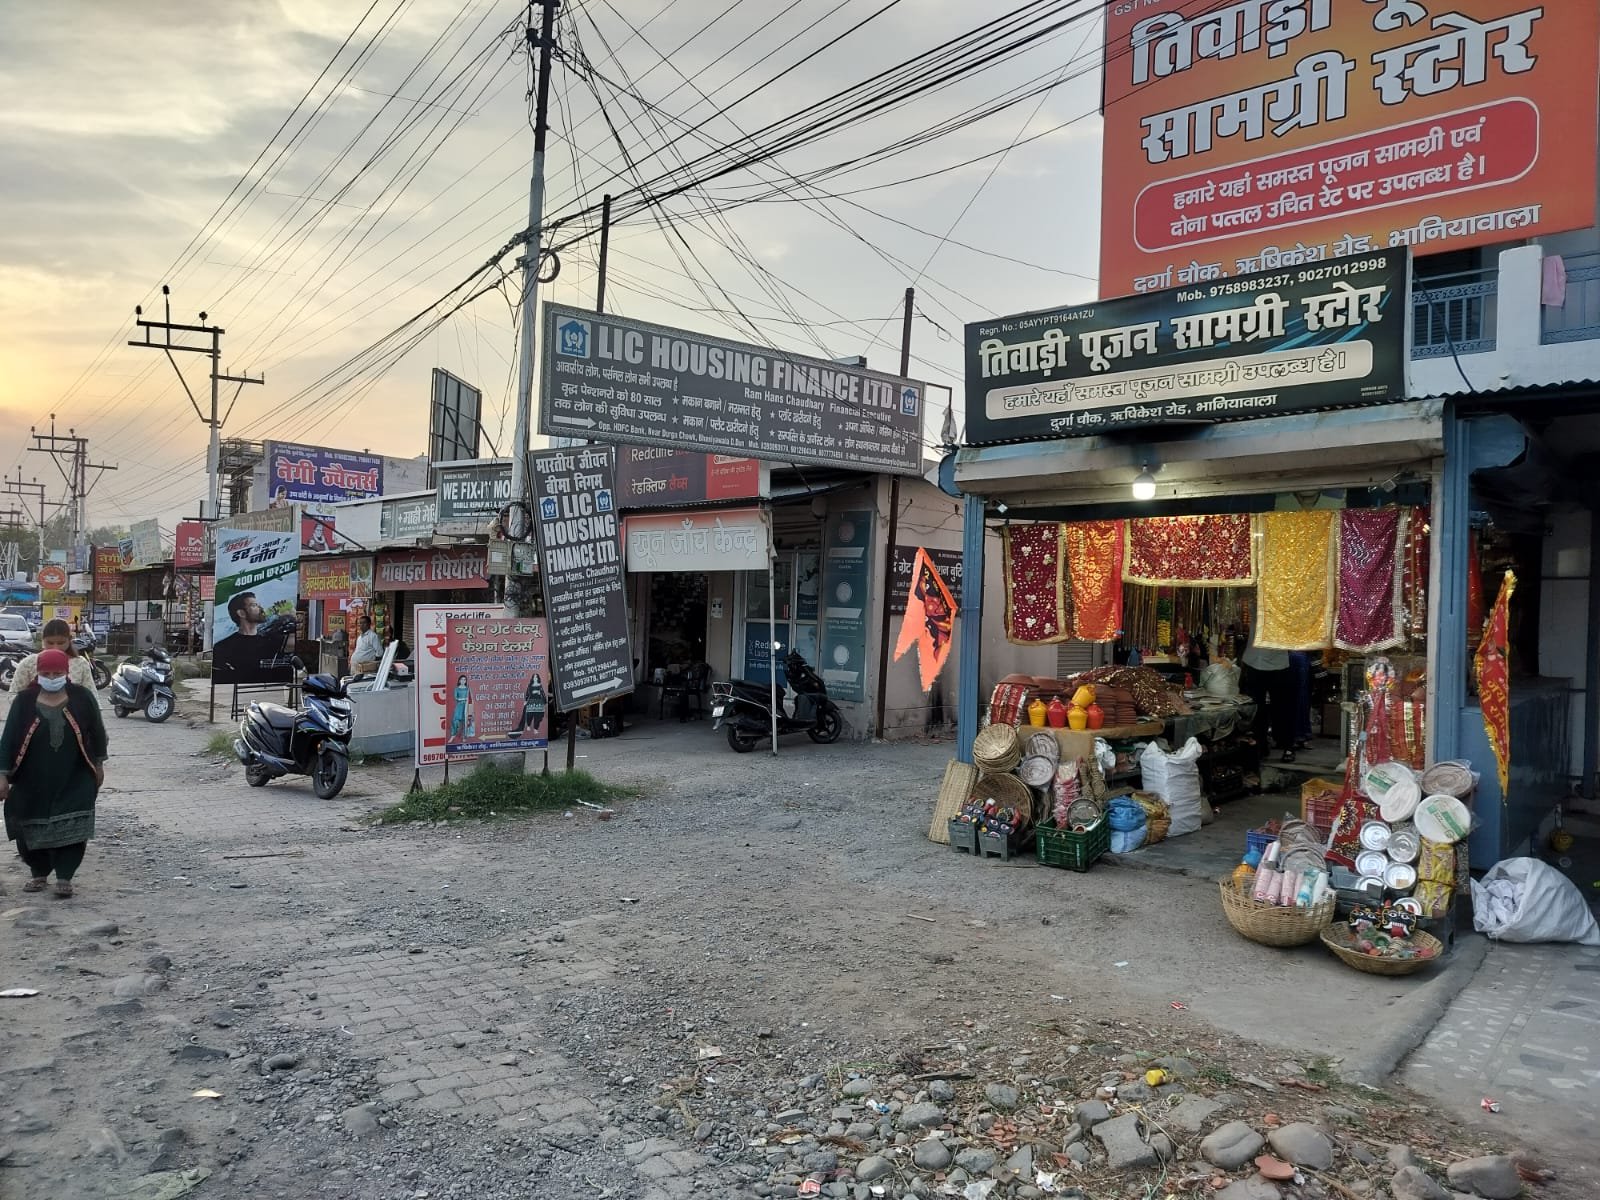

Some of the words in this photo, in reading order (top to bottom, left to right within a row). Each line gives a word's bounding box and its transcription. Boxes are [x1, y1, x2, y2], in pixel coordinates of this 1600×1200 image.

[1139, 50, 1356, 164] सामग्री
[1371, 6, 1543, 105] स्टोर
[1173, 179, 1216, 210] हमारे
[1219, 171, 1253, 198] यहां
[1256, 163, 1315, 190] समस्त
[1319, 149, 1371, 184] पूजन
[1374, 126, 1446, 164] सामग्री
[1450, 116, 1487, 148] एवं
[1170, 214, 1207, 236] दोना
[1211, 204, 1264, 229] पत्तल
[1266, 191, 1315, 219] उचित
[1318, 185, 1344, 208] रेट
[1347, 180, 1375, 200] पर
[1378, 163, 1452, 196] उपलब्ध
[1388, 204, 1542, 247] भानियावाला
[1177, 291, 1206, 303] Mob.
[1210, 274, 1294, 298] 9758983237,
[1298, 257, 1387, 282] 9027012998
[979, 328, 1071, 378] तिवाड़ी
[1078, 321, 1160, 372] पूजन
[1170, 292, 1290, 350] सामग्री
[1300, 281, 1387, 332] स्टोर
[979, 327, 1001, 336] Regn.
[556, 360, 584, 376] आवासीय
[624, 368, 638, 383] लोन
[599, 325, 644, 364] LIC
[651, 336, 768, 387] HOUSING
[772, 360, 859, 403] FINANCE
[862, 378, 897, 410] LTD.
[561, 382, 579, 397] वृद्ध
[616, 389, 629, 401] को
[630, 392, 642, 403] 80
[643, 395, 663, 407] साल
[1004, 388, 1043, 410] हमारे
[1044, 382, 1075, 404] यहाँ
[1075, 381, 1127, 401] समस्त
[1129, 374, 1176, 399] पूजन
[1177, 361, 1240, 388] सामग्री
[1243, 356, 1315, 380] उपलब्ध
[554, 398, 573, 409] तक
[573, 398, 593, 412] लोन
[595, 401, 608, 414] की
[610, 403, 636, 423] सुविधा
[637, 409, 668, 422] उपलब्ध
[682, 395, 703, 408] मकान
[744, 387, 762, 400] Ram
[764, 392, 784, 404] Hans
[786, 396, 825, 412] Chaudhary
[829, 403, 861, 417] Financial
[1050, 412, 1074, 431] दुर्गा
[1110, 405, 1162, 421] ऋषिकेश
[1165, 402, 1191, 416] रोड,
[1196, 394, 1278, 413] भानियावाला
[613, 423, 630, 433] HDFC
[682, 415, 704, 428] मकान
[275, 456, 317, 485] नेगी
[320, 463, 378, 491] ज्वैलर्स
[535, 452, 575, 474] भारतीय
[577, 450, 608, 469] जीवन
[443, 482, 459, 500] WE
[545, 475, 571, 494] बीमा
[574, 472, 603, 491] निगम
[631, 477, 667, 494] रेडक्लिफ
[562, 492, 593, 518] LIC
[543, 514, 616, 547] HOUSING
[249, 547, 280, 563] जीत
[545, 543, 596, 573] FINANCE
[596, 540, 619, 564] LTD.
[899, 558, 912, 575] ग्रेट
[235, 574, 253, 587] 400
[253, 570, 265, 581] ml
[548, 574, 564, 586] Ram
[586, 565, 620, 579] Chaudhary
[455, 624, 475, 639] न्यू
[490, 623, 511, 637] ग्रेट
